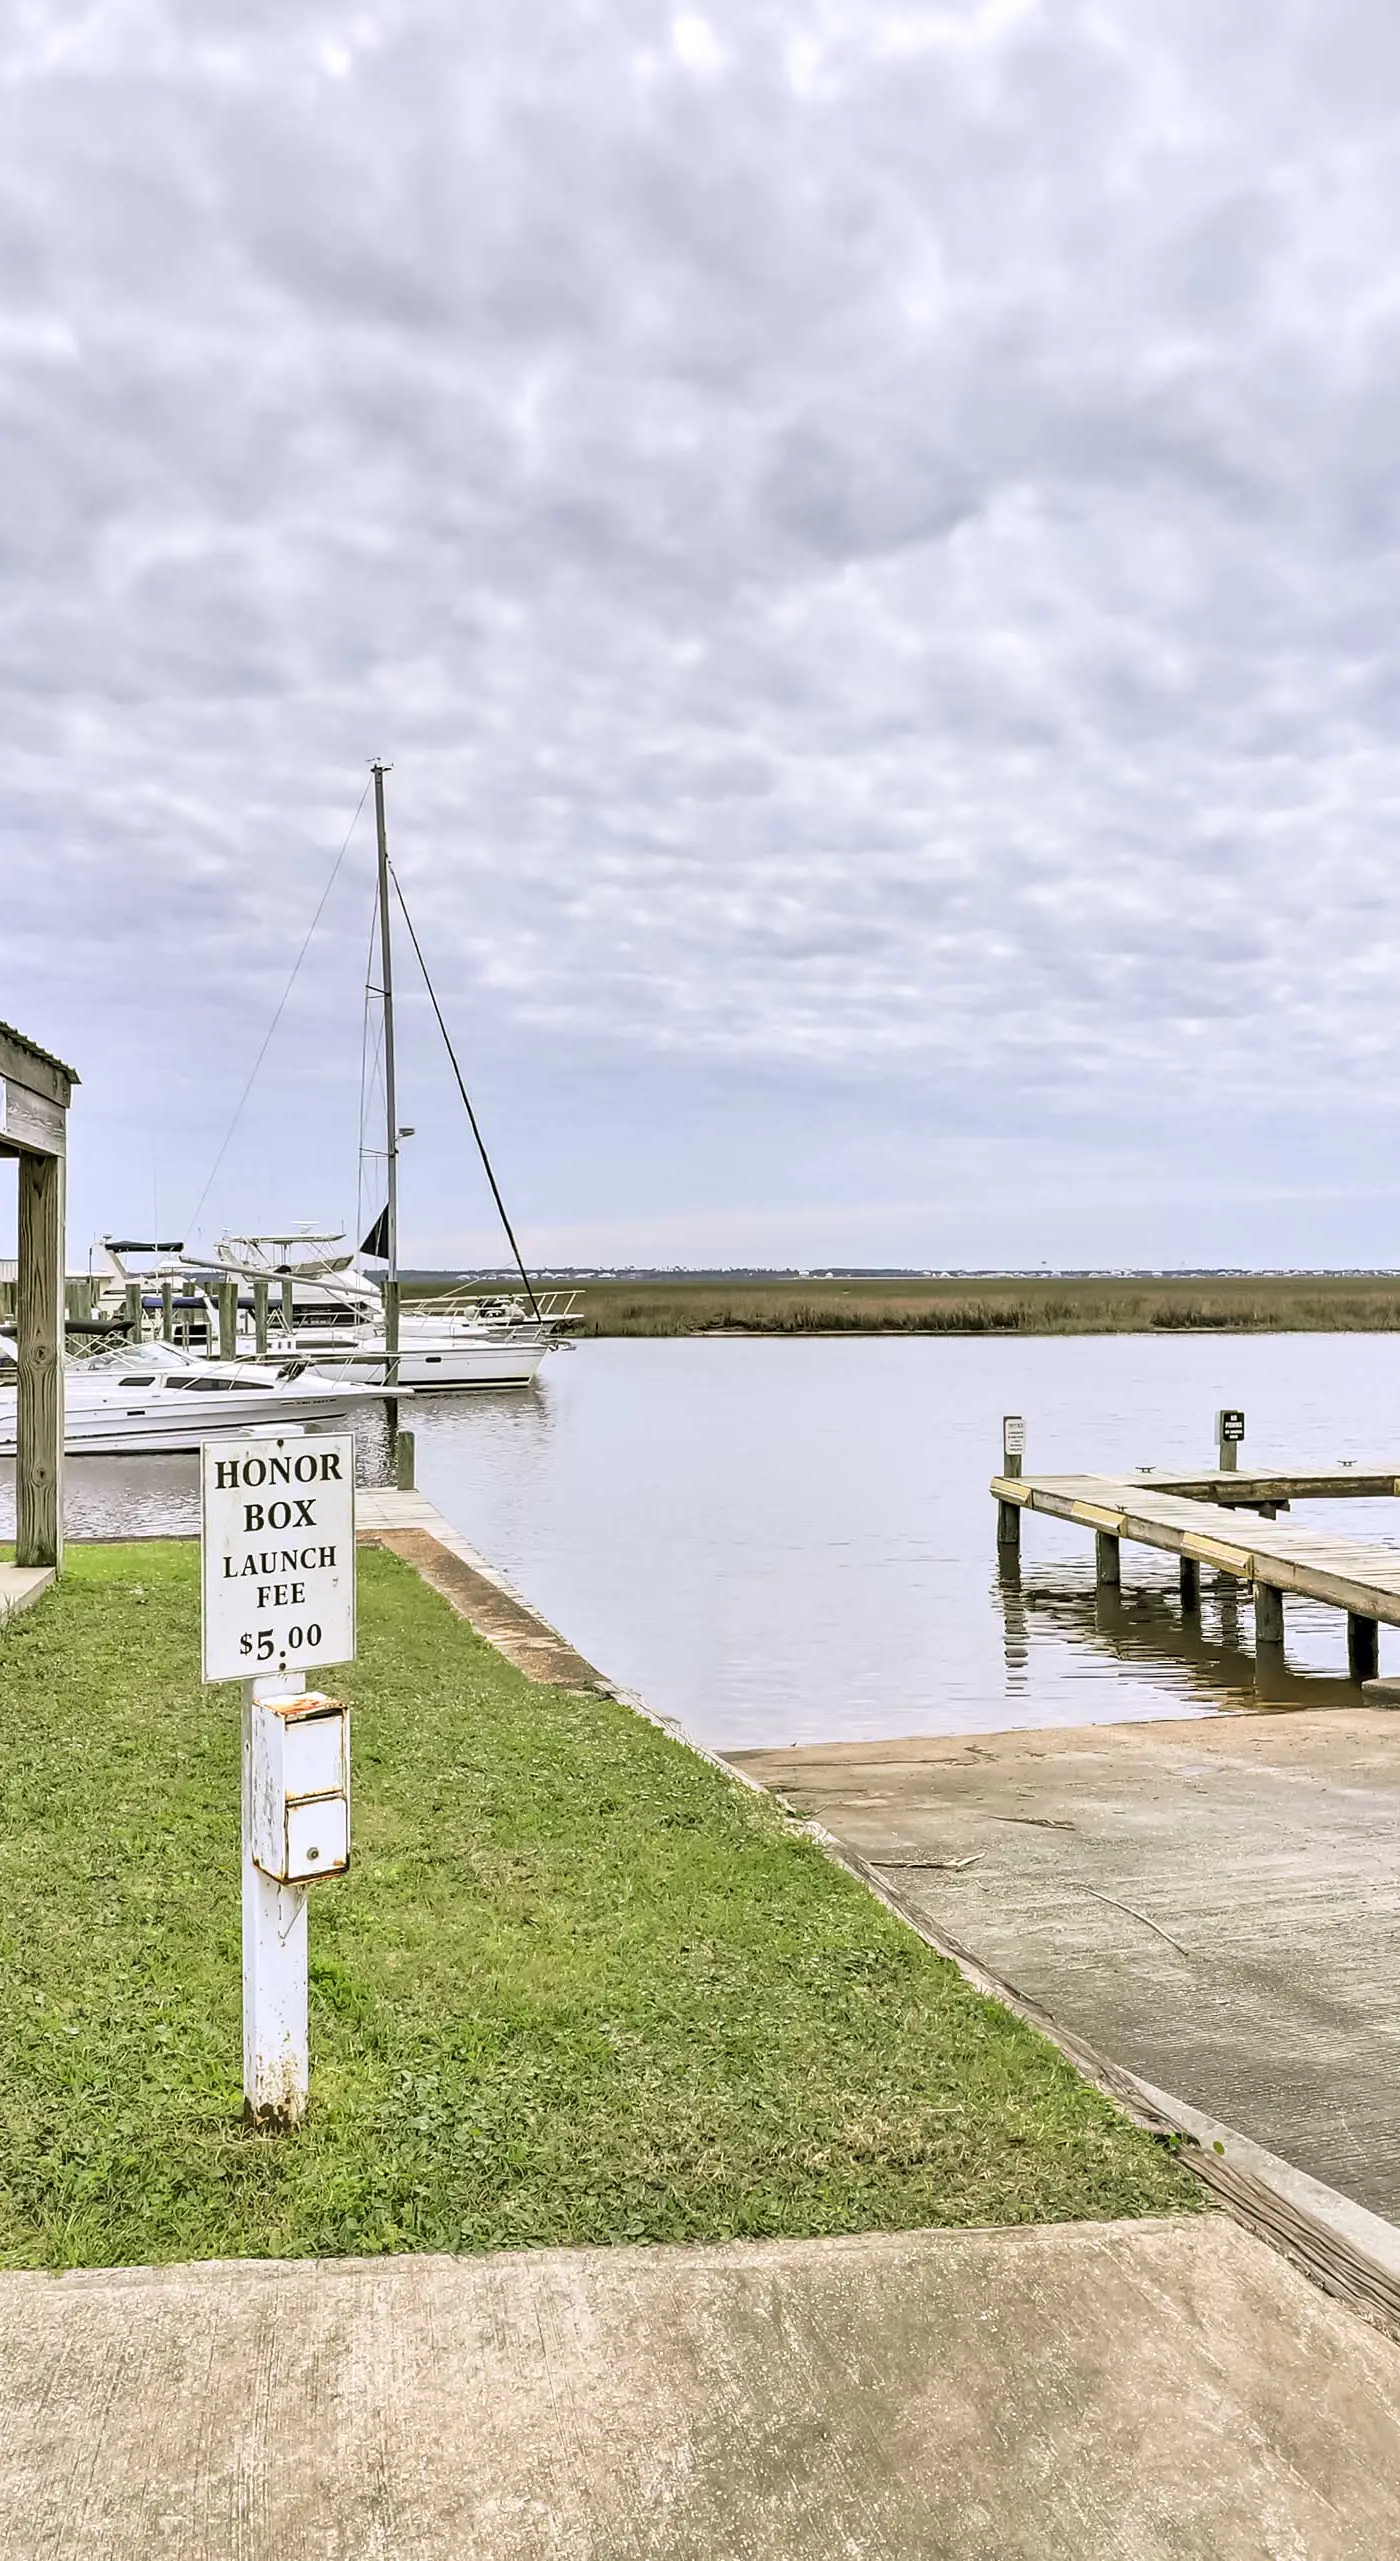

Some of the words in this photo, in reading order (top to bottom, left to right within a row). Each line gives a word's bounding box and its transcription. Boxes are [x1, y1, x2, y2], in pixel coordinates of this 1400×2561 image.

[214, 1453, 343, 1490] HONOR
[243, 1498, 317, 1533] BOX
[223, 1545, 337, 1579] LAUNCH
[256, 1582, 306, 1609] FEE
[239, 1623, 322, 1661] $5.00
